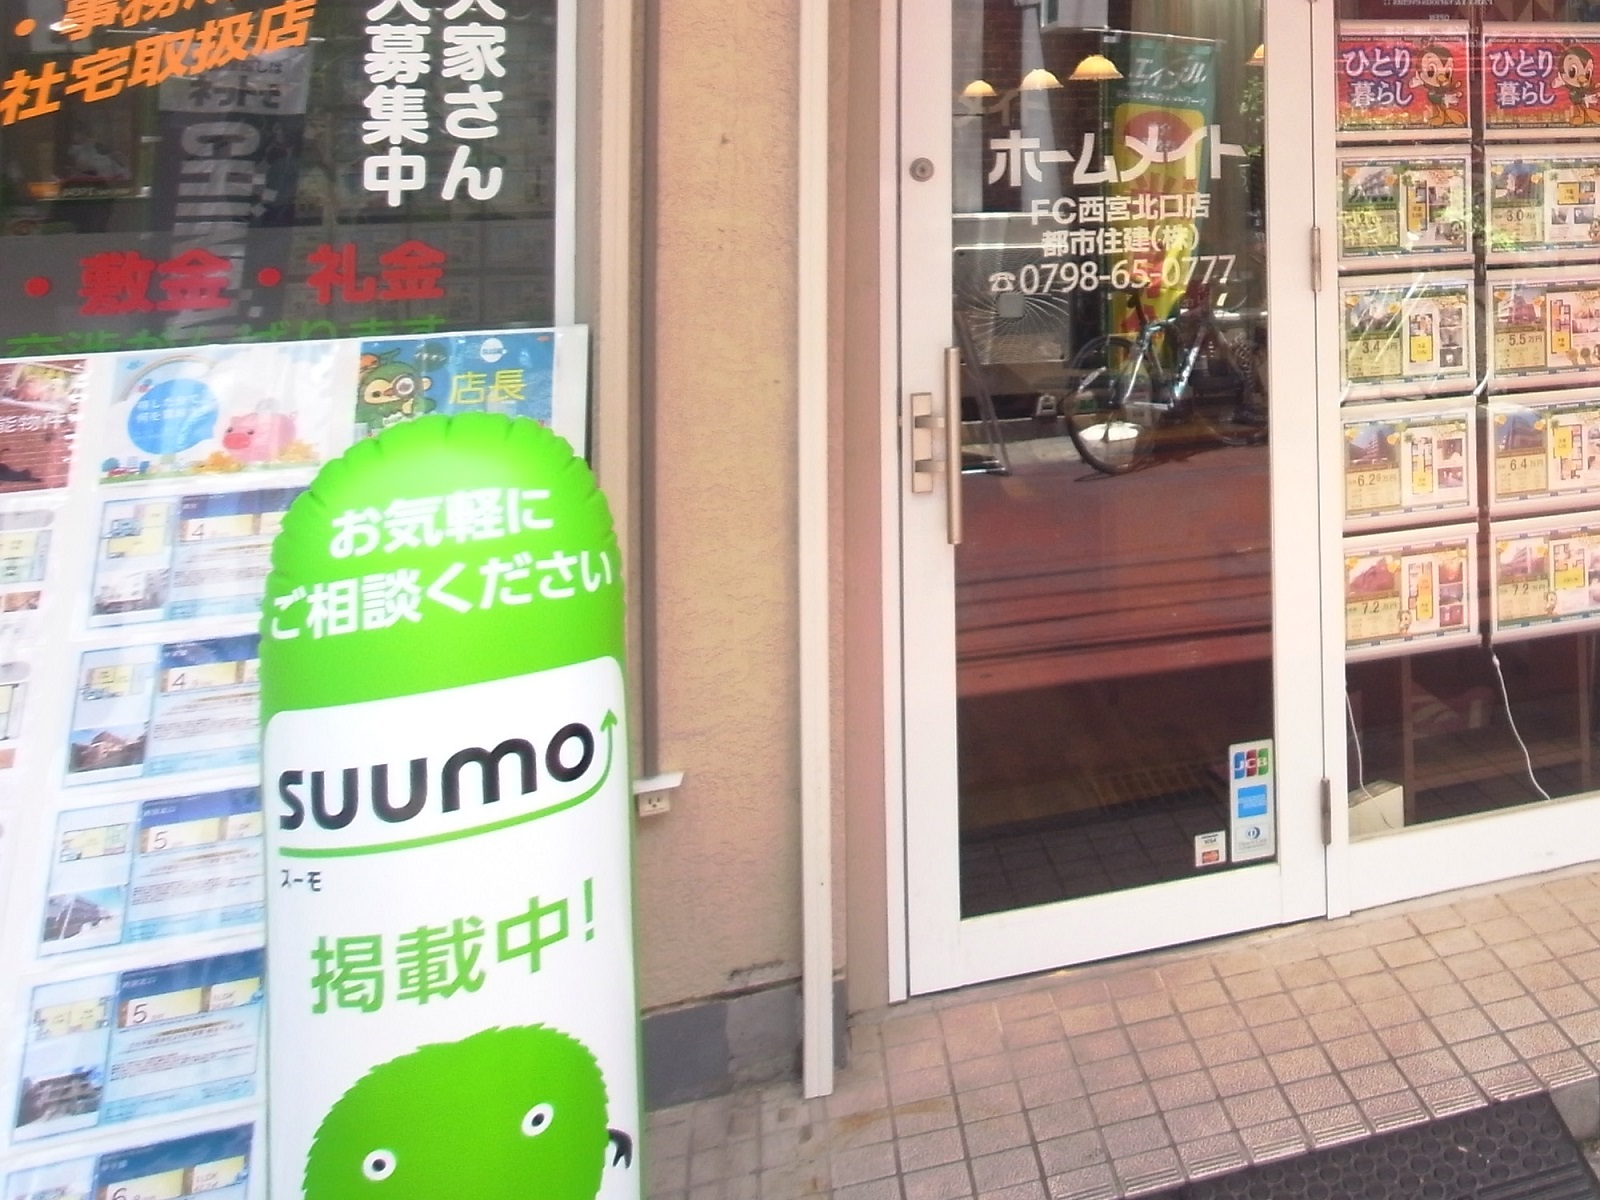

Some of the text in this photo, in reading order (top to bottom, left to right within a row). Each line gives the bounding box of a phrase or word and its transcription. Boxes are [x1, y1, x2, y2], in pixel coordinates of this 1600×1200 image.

[1342, 46, 1410, 78] ひとり
[1489, 47, 1554, 78] ひとり
[1349, 80, 1414, 107] 暮らし
[1496, 80, 1555, 106] 暮らし
[988, 124, 1248, 187] ホームメイト
[1030, 193, 1211, 226] FC西宮北口店
[1019, 255, 1237, 294] 0798-65-0777
[449, 369, 528, 405] 店長
[329, 485, 555, 561] お気軽に
[267, 546, 616, 642] ご相談ください
[280, 868, 323, 894] スーモ
[310, 877, 599, 1016] 掲載中!
